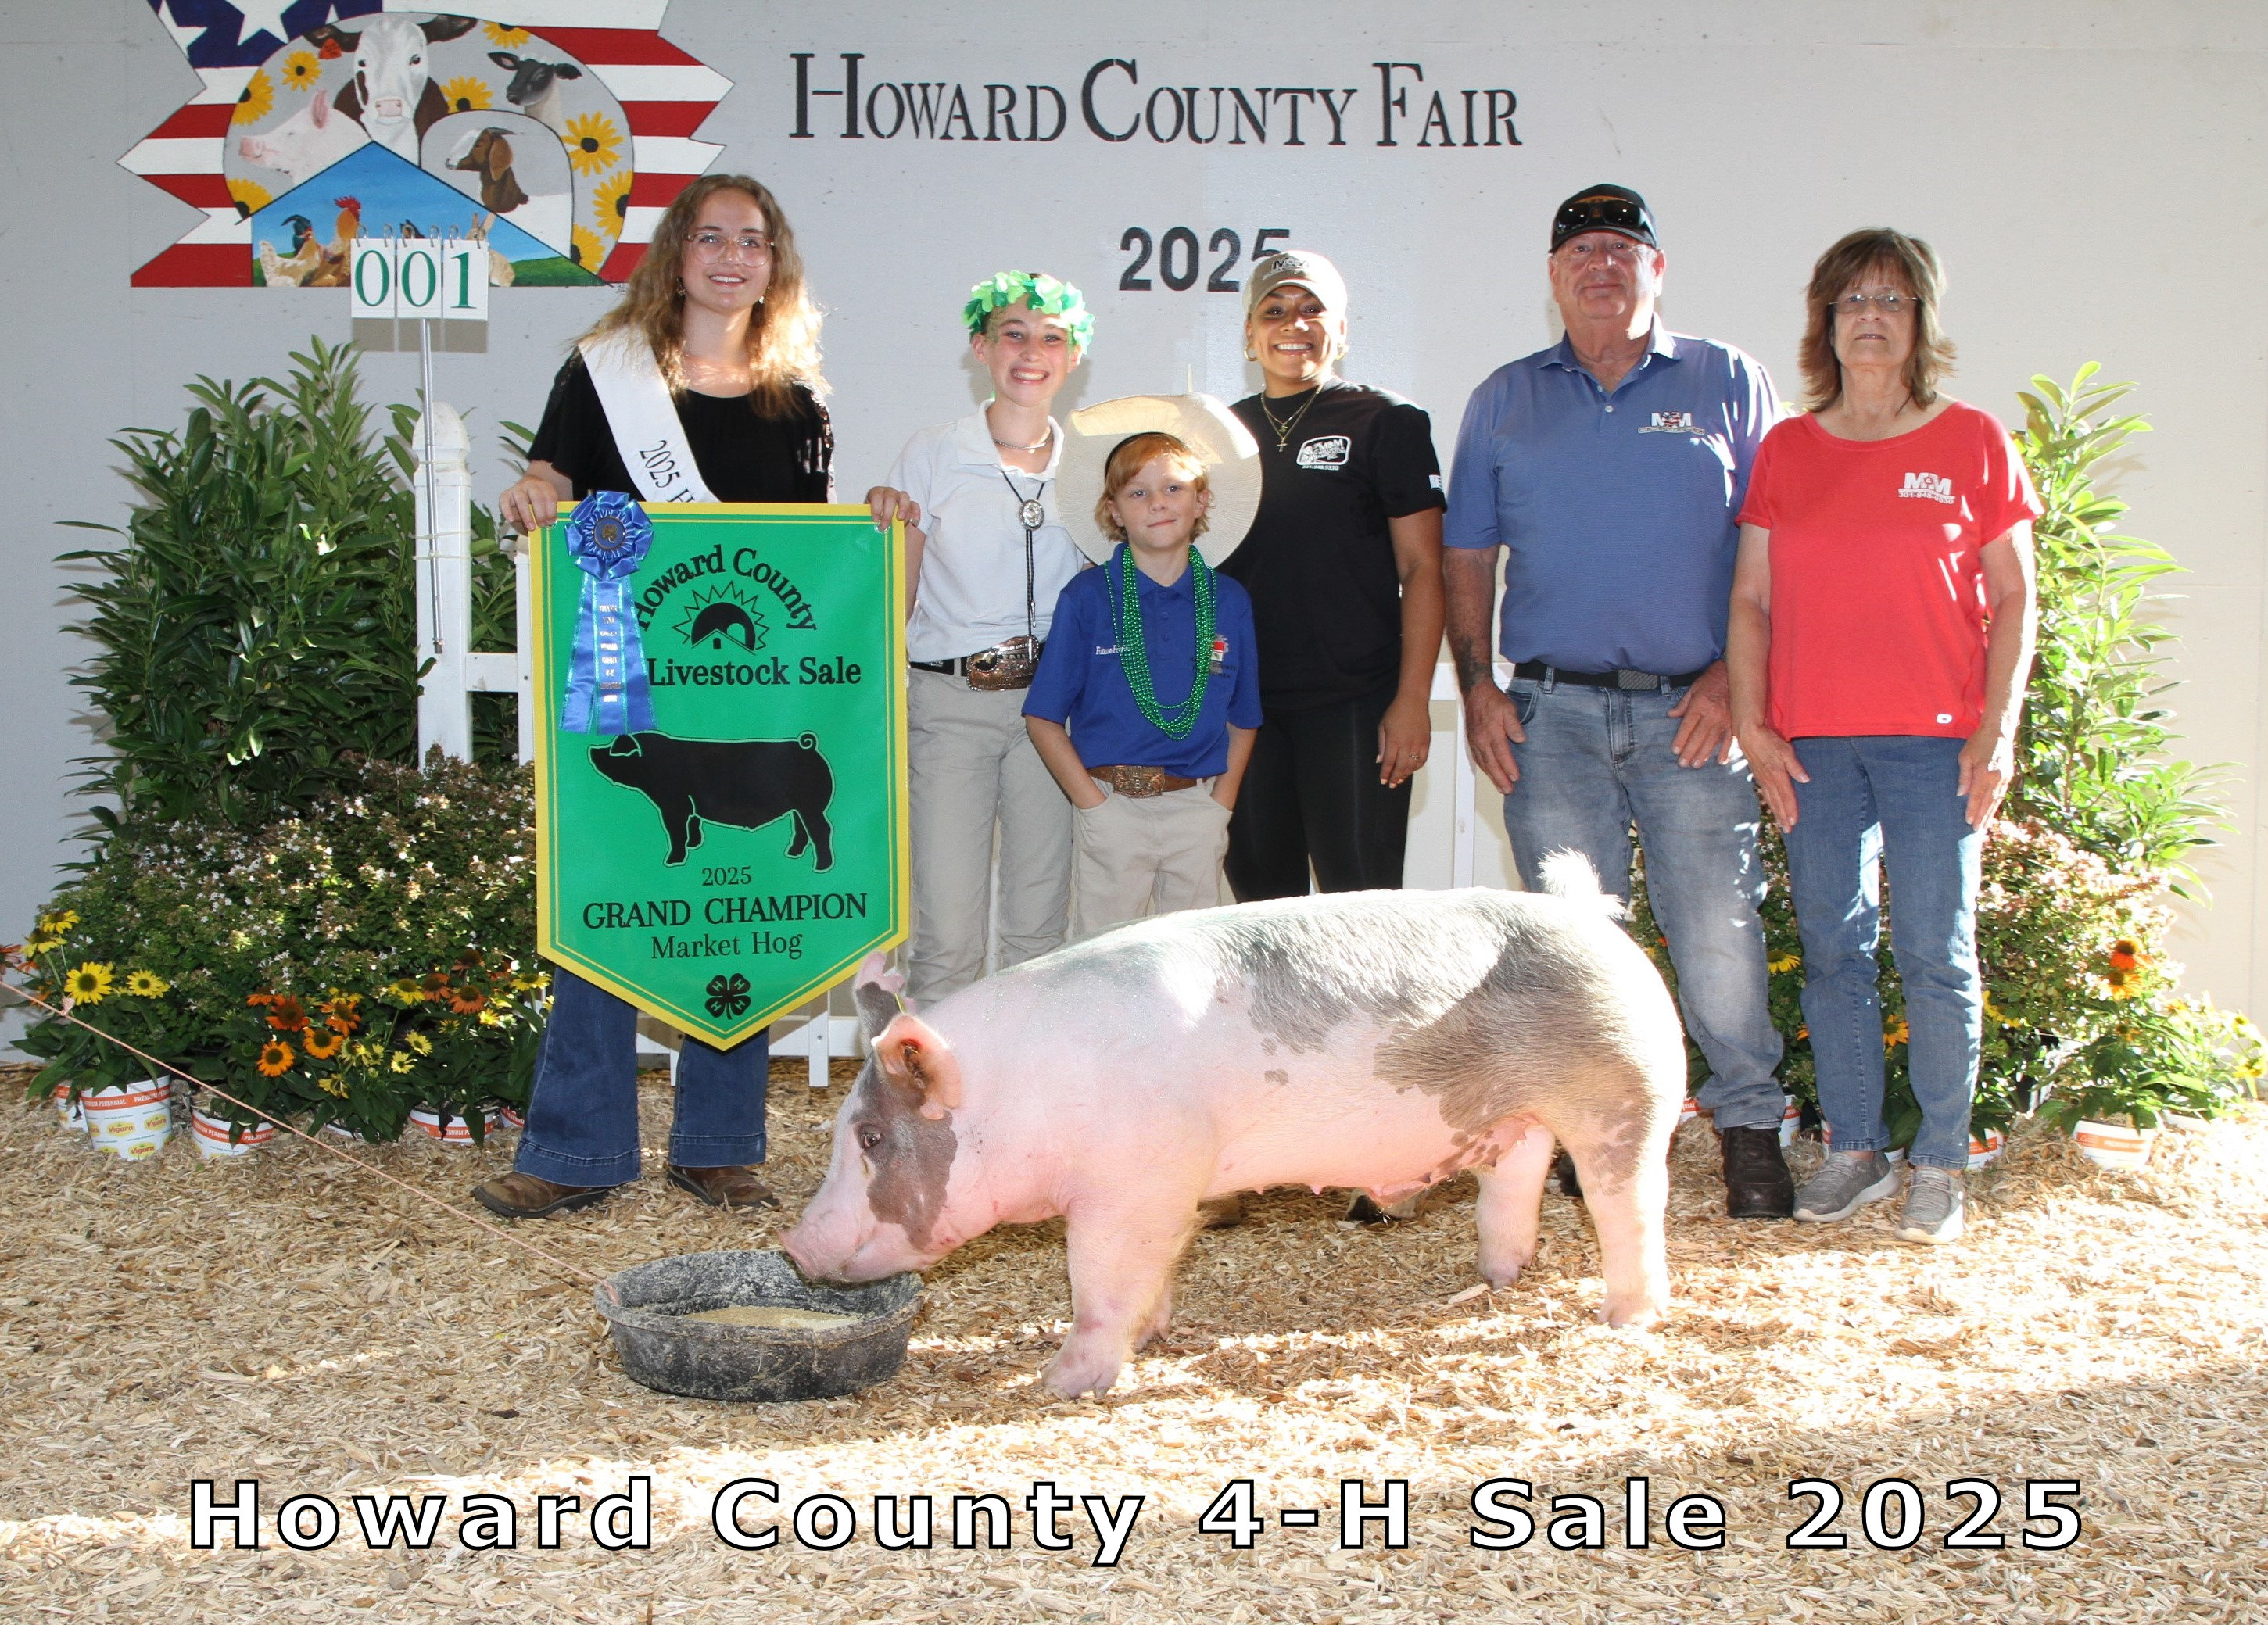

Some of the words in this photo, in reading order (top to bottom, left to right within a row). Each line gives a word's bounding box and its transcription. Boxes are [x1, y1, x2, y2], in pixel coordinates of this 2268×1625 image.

[789, 53, 1066, 141] HOWARD
[1081, 59, 1357, 145] COUNTY
[1372, 63, 1523, 147] FAIR
[355, 249, 477, 309] 001
[638, 439, 680, 489] 2025
[635, 544, 726, 632] Howard
[733, 548, 817, 631] County
[647, 657, 790, 686] Livestock
[799, 656, 862, 685] Sale
[701, 866, 751, 886] 2025
[582, 900, 691, 929] GRAND
[704, 893, 868, 925] CHAMPION
[651, 933, 740, 959] Market
[752, 931, 803, 960] Hog
